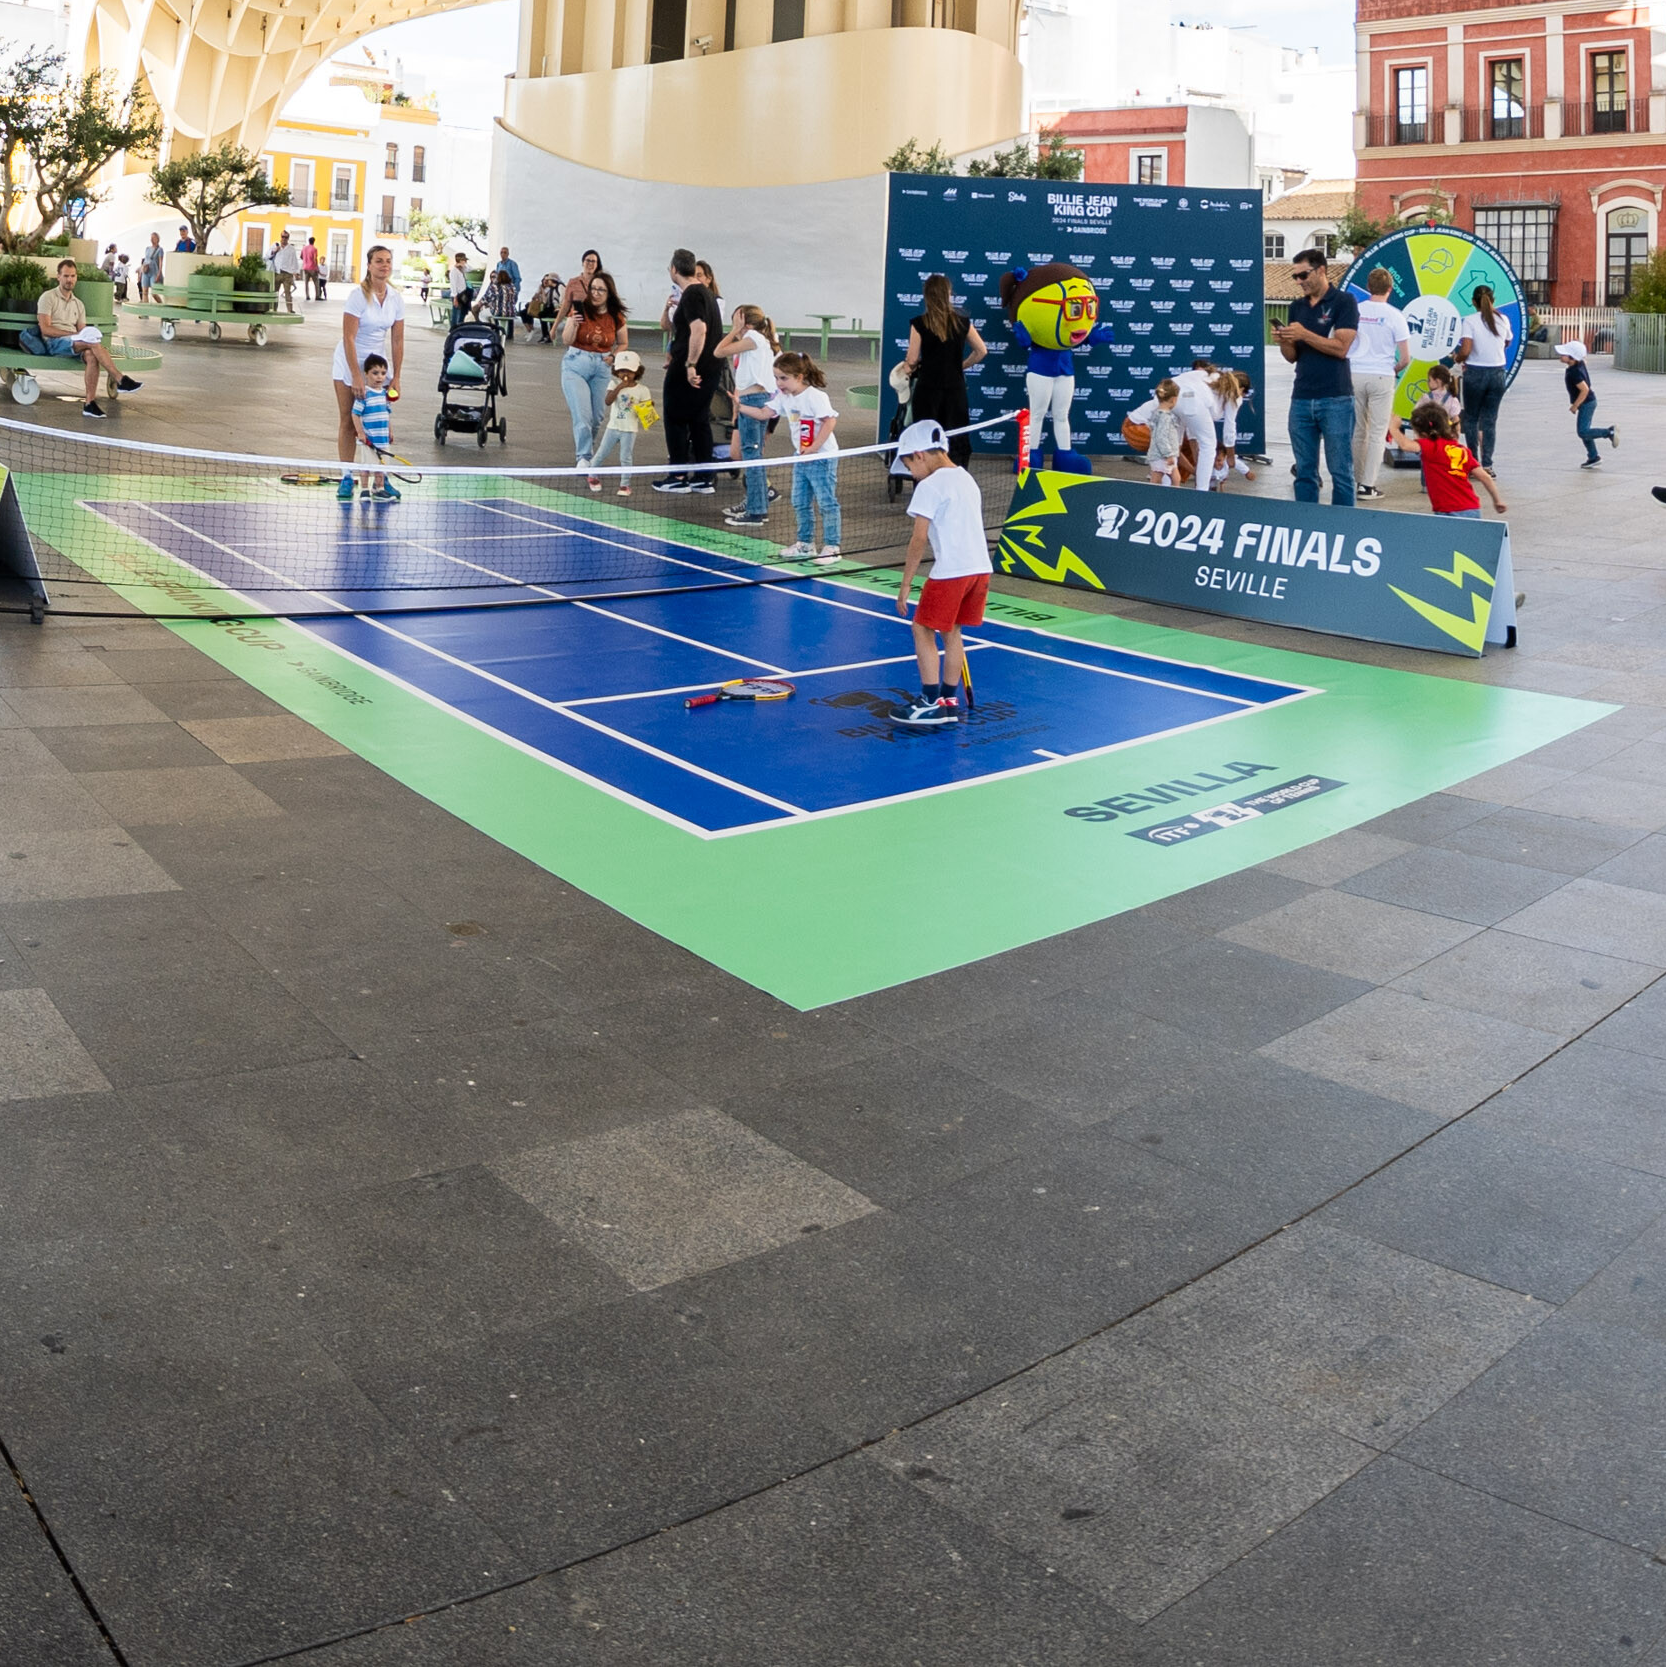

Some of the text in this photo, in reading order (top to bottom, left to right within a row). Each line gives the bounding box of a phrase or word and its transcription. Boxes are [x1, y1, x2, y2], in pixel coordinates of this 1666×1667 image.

[1047, 193, 1118, 207] BILLIE JEAN
[1054, 204, 1112, 217] KING CUP
[1128, 508, 1382, 577] 2024 FINALS
[1194, 565, 1288, 599] SEVILLE
[225, 627, 285, 651] CUP
[296, 666, 373, 706] GAINBRIDGE
[1063, 761, 1281, 822] SEVILLA
[1244, 797, 1270, 807] THE
[1153, 824, 1193, 842] ITF
